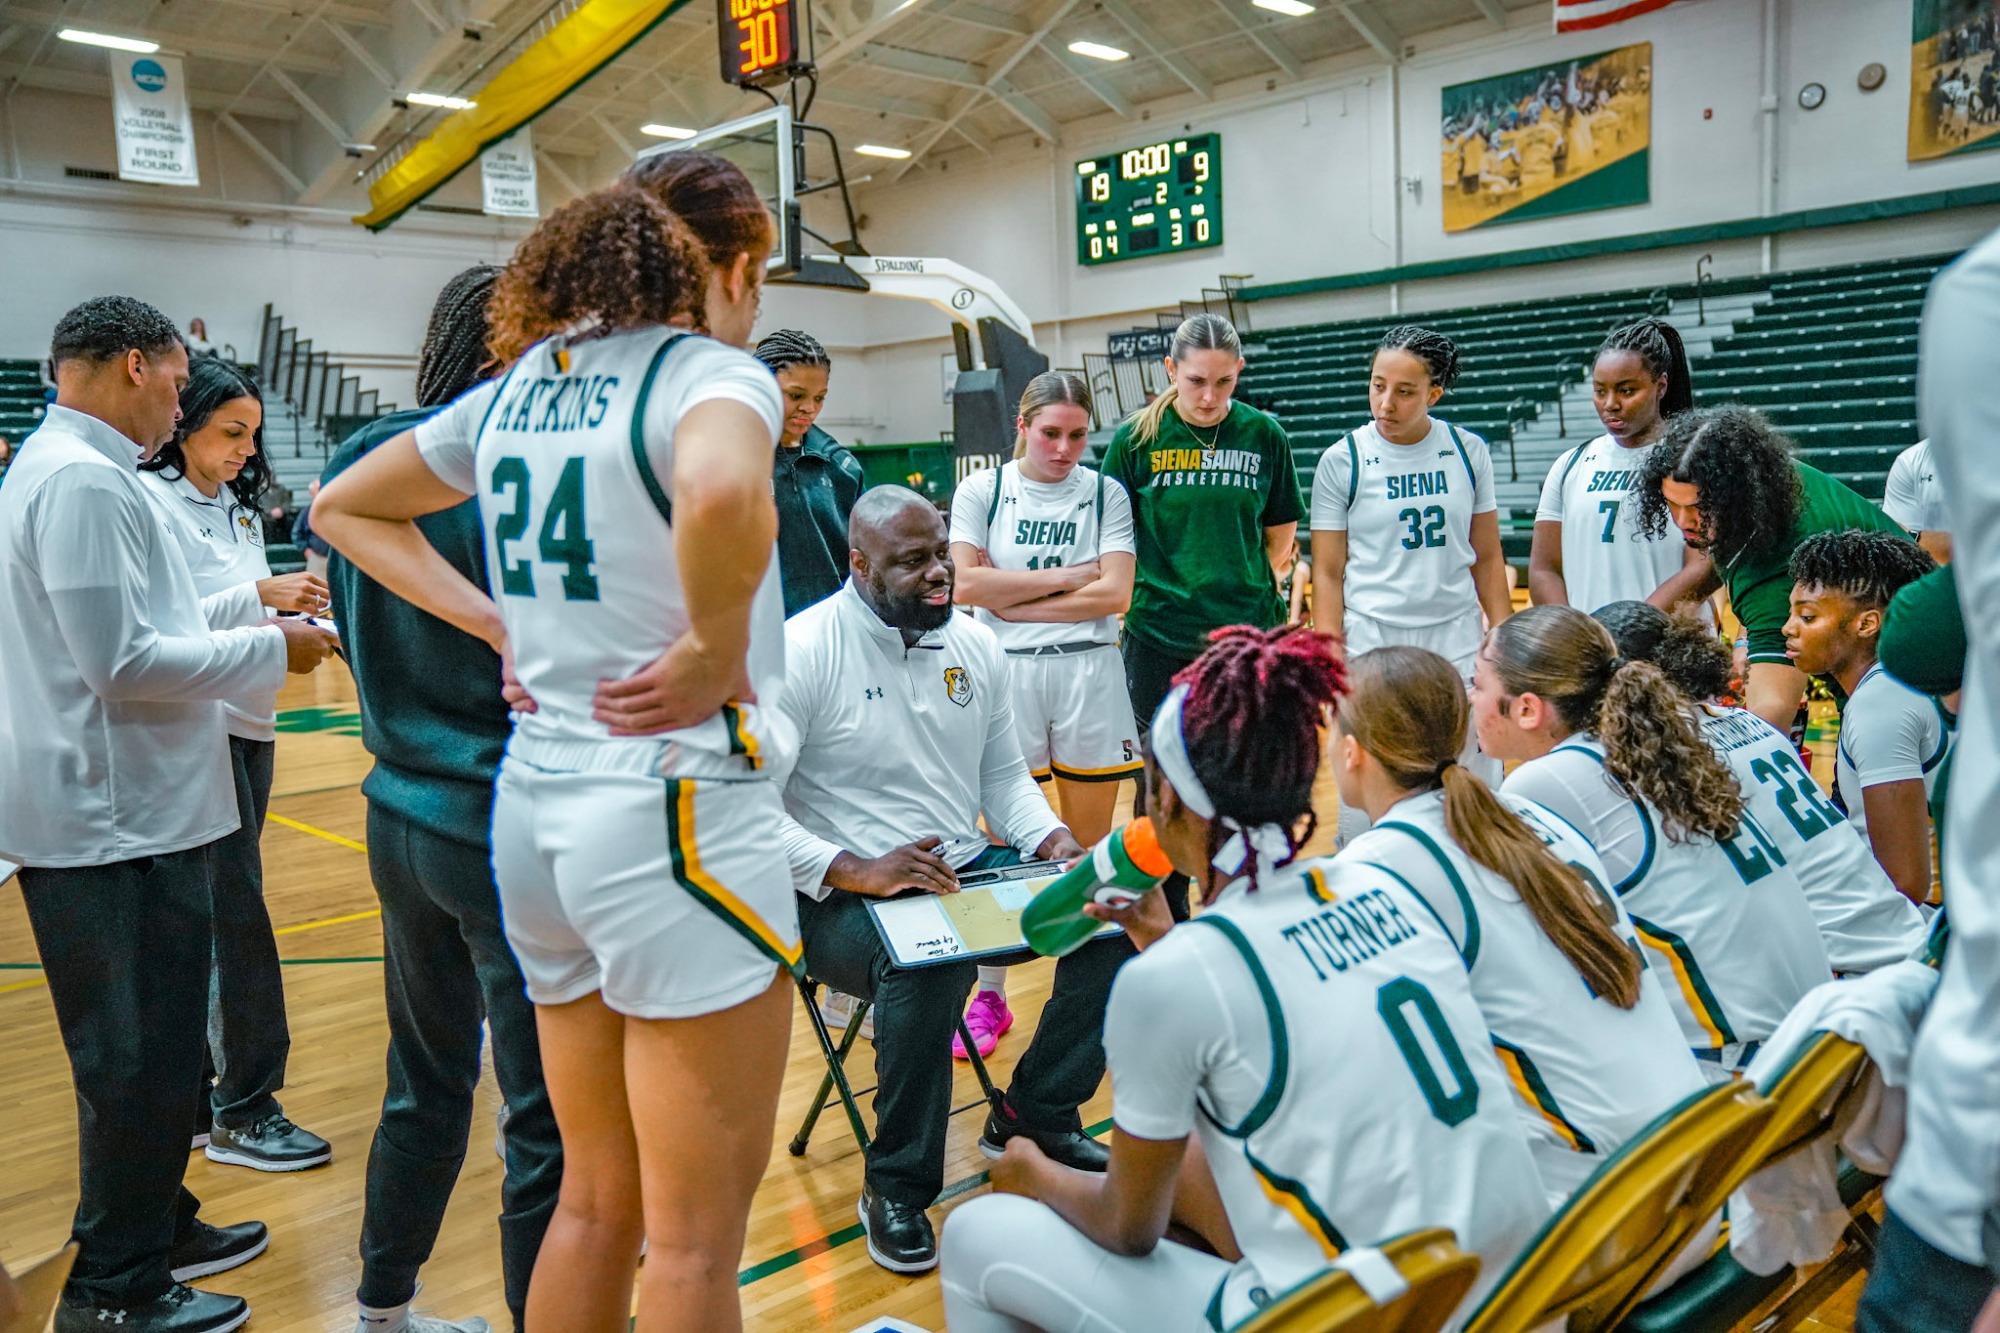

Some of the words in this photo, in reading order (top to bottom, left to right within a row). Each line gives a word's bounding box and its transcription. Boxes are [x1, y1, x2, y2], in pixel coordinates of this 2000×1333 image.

[738, 10, 778, 73] 30
[121, 118, 182, 133] VOLLEYBALL
[131, 158, 182, 172] ROUND
[135, 147, 174, 159] FIRST
[1122, 143, 1171, 180] 10:00
[1193, 151, 1210, 183] 9
[494, 187, 523, 197] FIRST
[1091, 172, 1111, 202] 19
[1155, 181, 1168, 205] 2
[1090, 236, 1104, 259] 0
[1106, 235, 1119, 255] 4
[1171, 222, 1183, 246] 3
[1196, 218, 1210, 241] 0
[875, 259, 924, 273] SPALDING
[1151, 471, 1258, 491] BASKETBALL
[1385, 470, 1449, 500] SIENA
[492, 456, 600, 602] 24
[1015, 519, 1077, 546] SIENA
[1398, 504, 1447, 550] 32
[1598, 500, 1621, 544] 7
[1749, 749, 1847, 842] 22
[1281, 888, 1418, 982] TURNER
[1376, 975, 1480, 1128] 0
